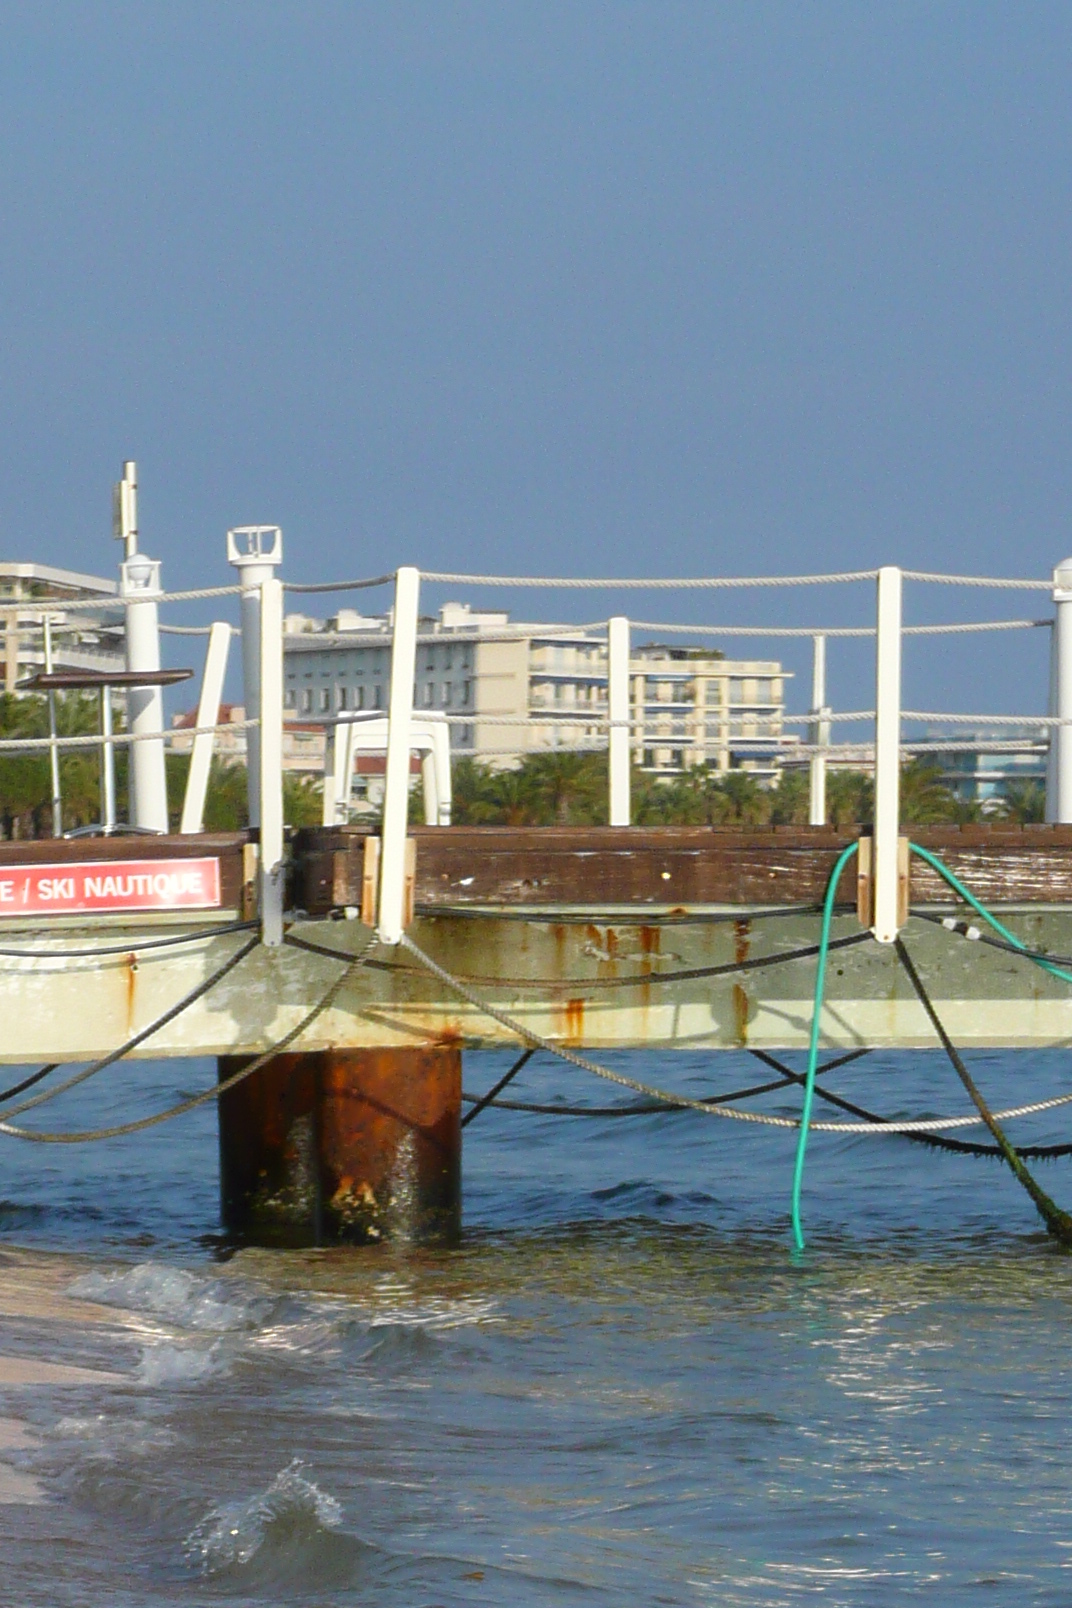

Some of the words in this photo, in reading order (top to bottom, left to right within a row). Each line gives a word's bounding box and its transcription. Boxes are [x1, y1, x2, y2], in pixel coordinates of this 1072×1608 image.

[22, 878, 31, 905] /
[38, 878, 75, 901] SKI
[85, 872, 204, 899] NAUTIQUE
